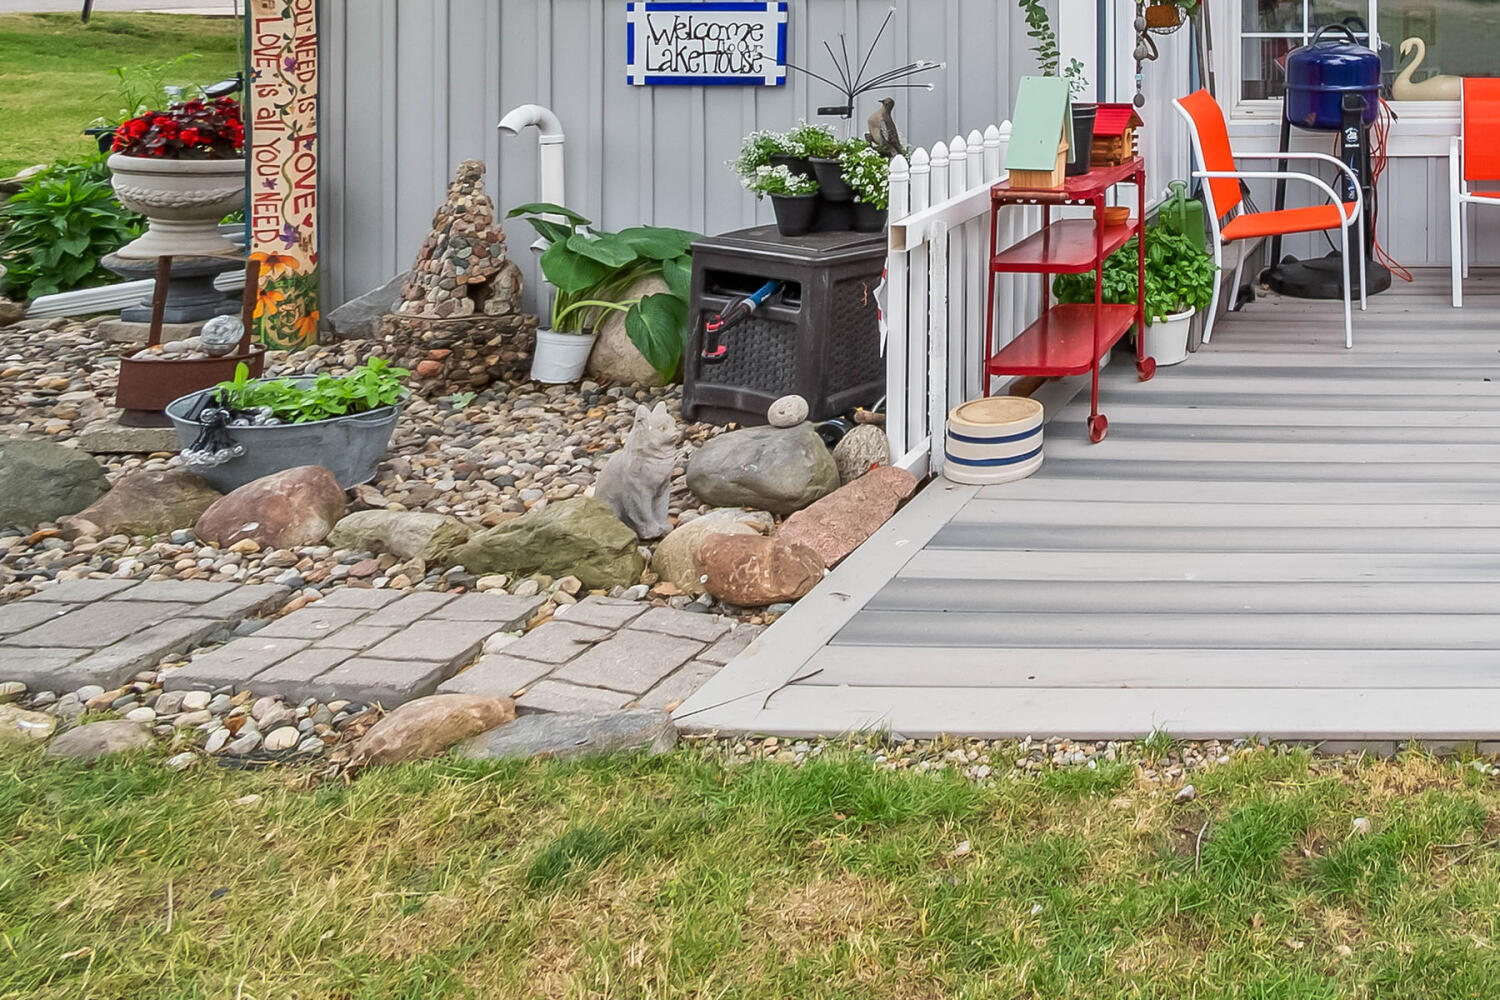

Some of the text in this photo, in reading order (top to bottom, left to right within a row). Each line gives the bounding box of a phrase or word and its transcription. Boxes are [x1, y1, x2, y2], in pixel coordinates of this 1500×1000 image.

[253, 17, 283, 68] LOVE
[646, 13, 764, 45] Welcome
[294, 33, 317, 83] NEED
[255, 83, 282, 98] is
[254, 107, 285, 131] all
[252, 137, 281, 177] YOU
[293, 134, 317, 215] LOVE
